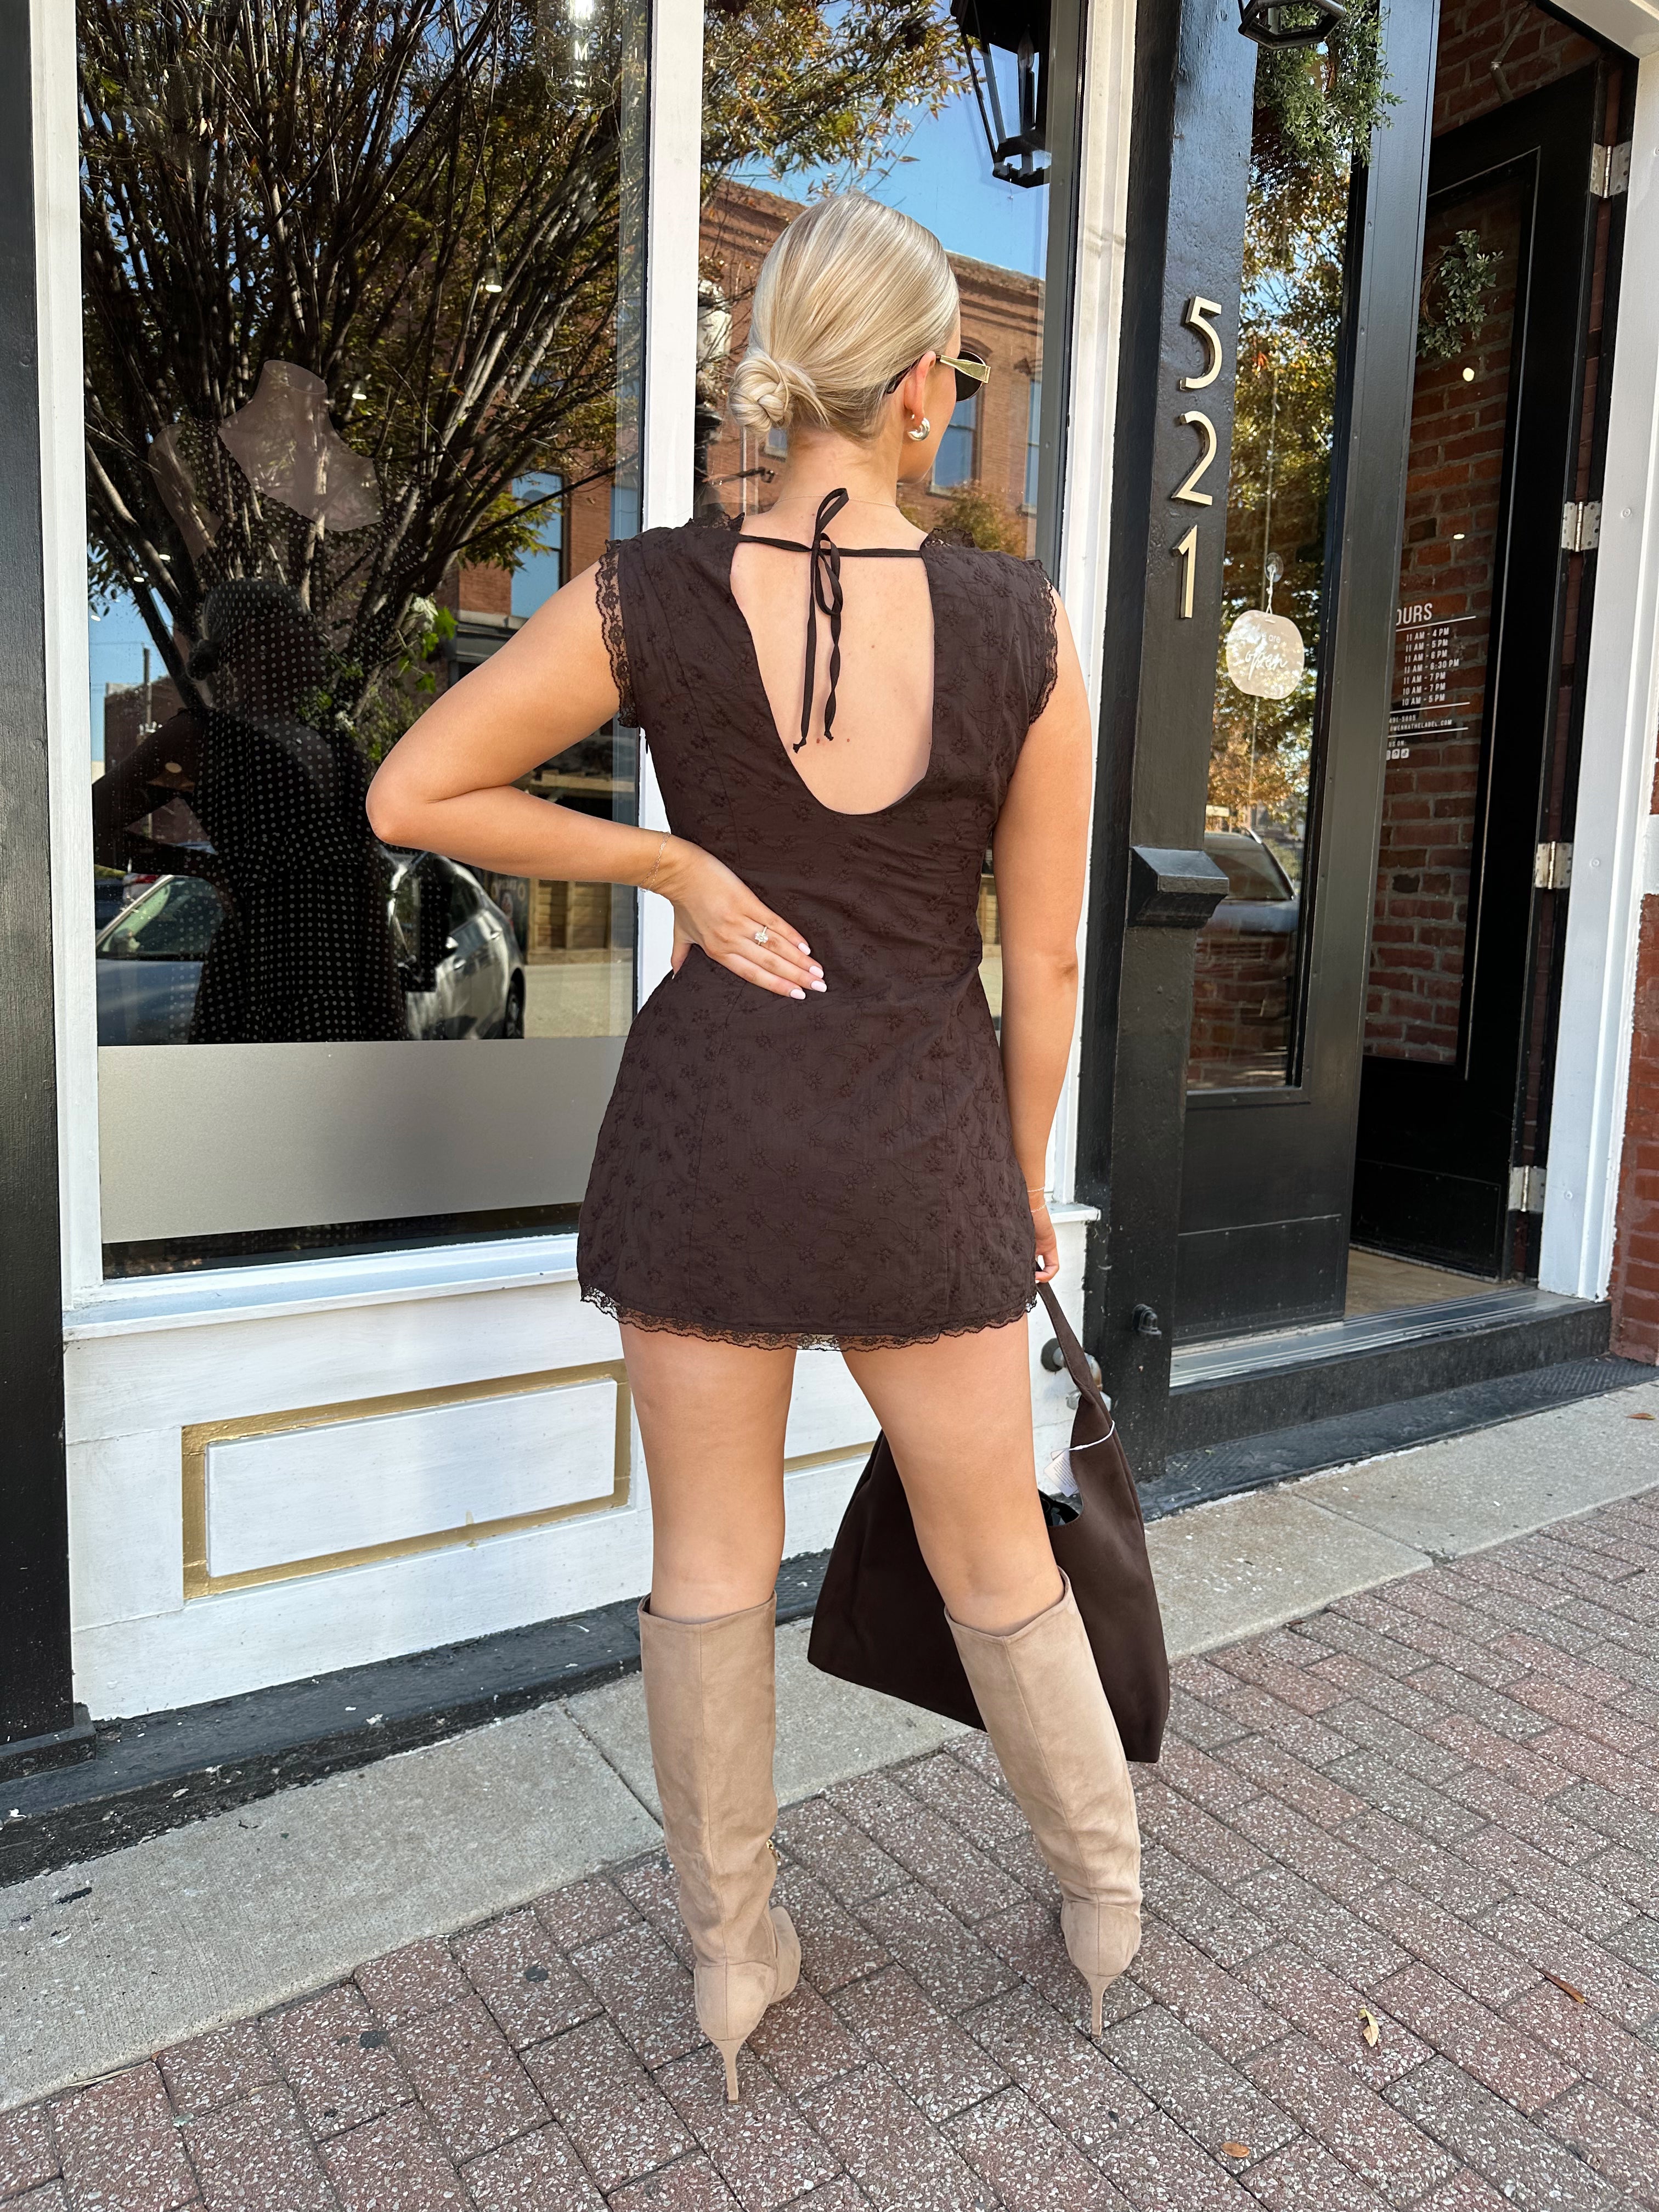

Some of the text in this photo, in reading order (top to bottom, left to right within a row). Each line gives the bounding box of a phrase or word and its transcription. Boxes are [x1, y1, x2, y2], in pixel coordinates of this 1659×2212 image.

[1171, 296, 1222, 619] 521
[1268, 634, 1281, 642] are
[1406, 633, 1412, 642] 11
[1414, 631, 1425, 640] AM
[1438, 627, 1449, 636] PM
[1406, 644, 1411, 653] 11
[1414, 642, 1424, 651] AM
[1431, 640, 1436, 648] 5
[1437, 639, 1448, 647] PM
[1405, 655, 1411, 663] 11
[1413, 653, 1424, 662] AM
[1431, 651, 1435, 659] 6
[1437, 649, 1448, 658] PM
[1243, 650, 1288, 681] open
[1404, 665, 1410, 674] 11
[1412, 664, 1423, 673] AM
[1430, 661, 1447, 670] 6:30
[1448, 658, 1460, 668] PM
[1403, 676, 1410, 685] 11
[1412, 675, 1423, 684] AM
[1430, 673, 1434, 681] 7
[1435, 672, 1446, 680] PM
[1402, 687, 1410, 696] 10
[1411, 685, 1422, 694] AM
[1430, 684, 1434, 692] 7
[1435, 682, 1446, 691] PM
[1402, 698, 1409, 707] 10
[1410, 696, 1421, 705] AM
[1429, 695, 1433, 703] 5
[1435, 693, 1445, 702] PM
